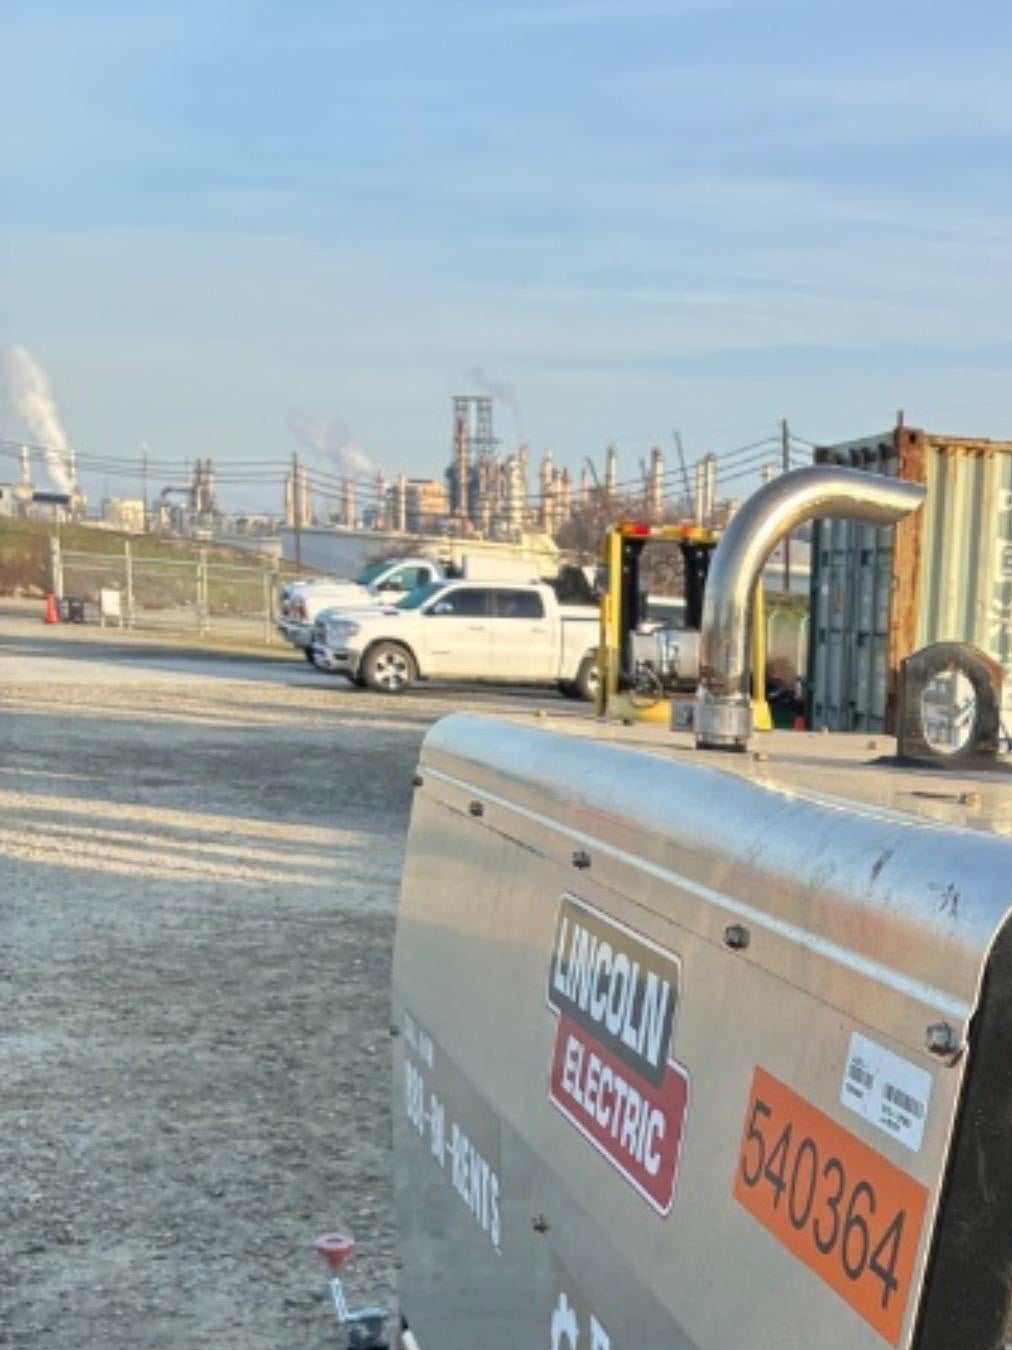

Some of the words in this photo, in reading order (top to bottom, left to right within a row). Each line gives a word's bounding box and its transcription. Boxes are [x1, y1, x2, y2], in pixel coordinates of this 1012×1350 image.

[553, 914, 672, 1068] LINCOLN
[559, 1033, 668, 1178] ELECTRIC
[742, 1097, 908, 1311] 540364
